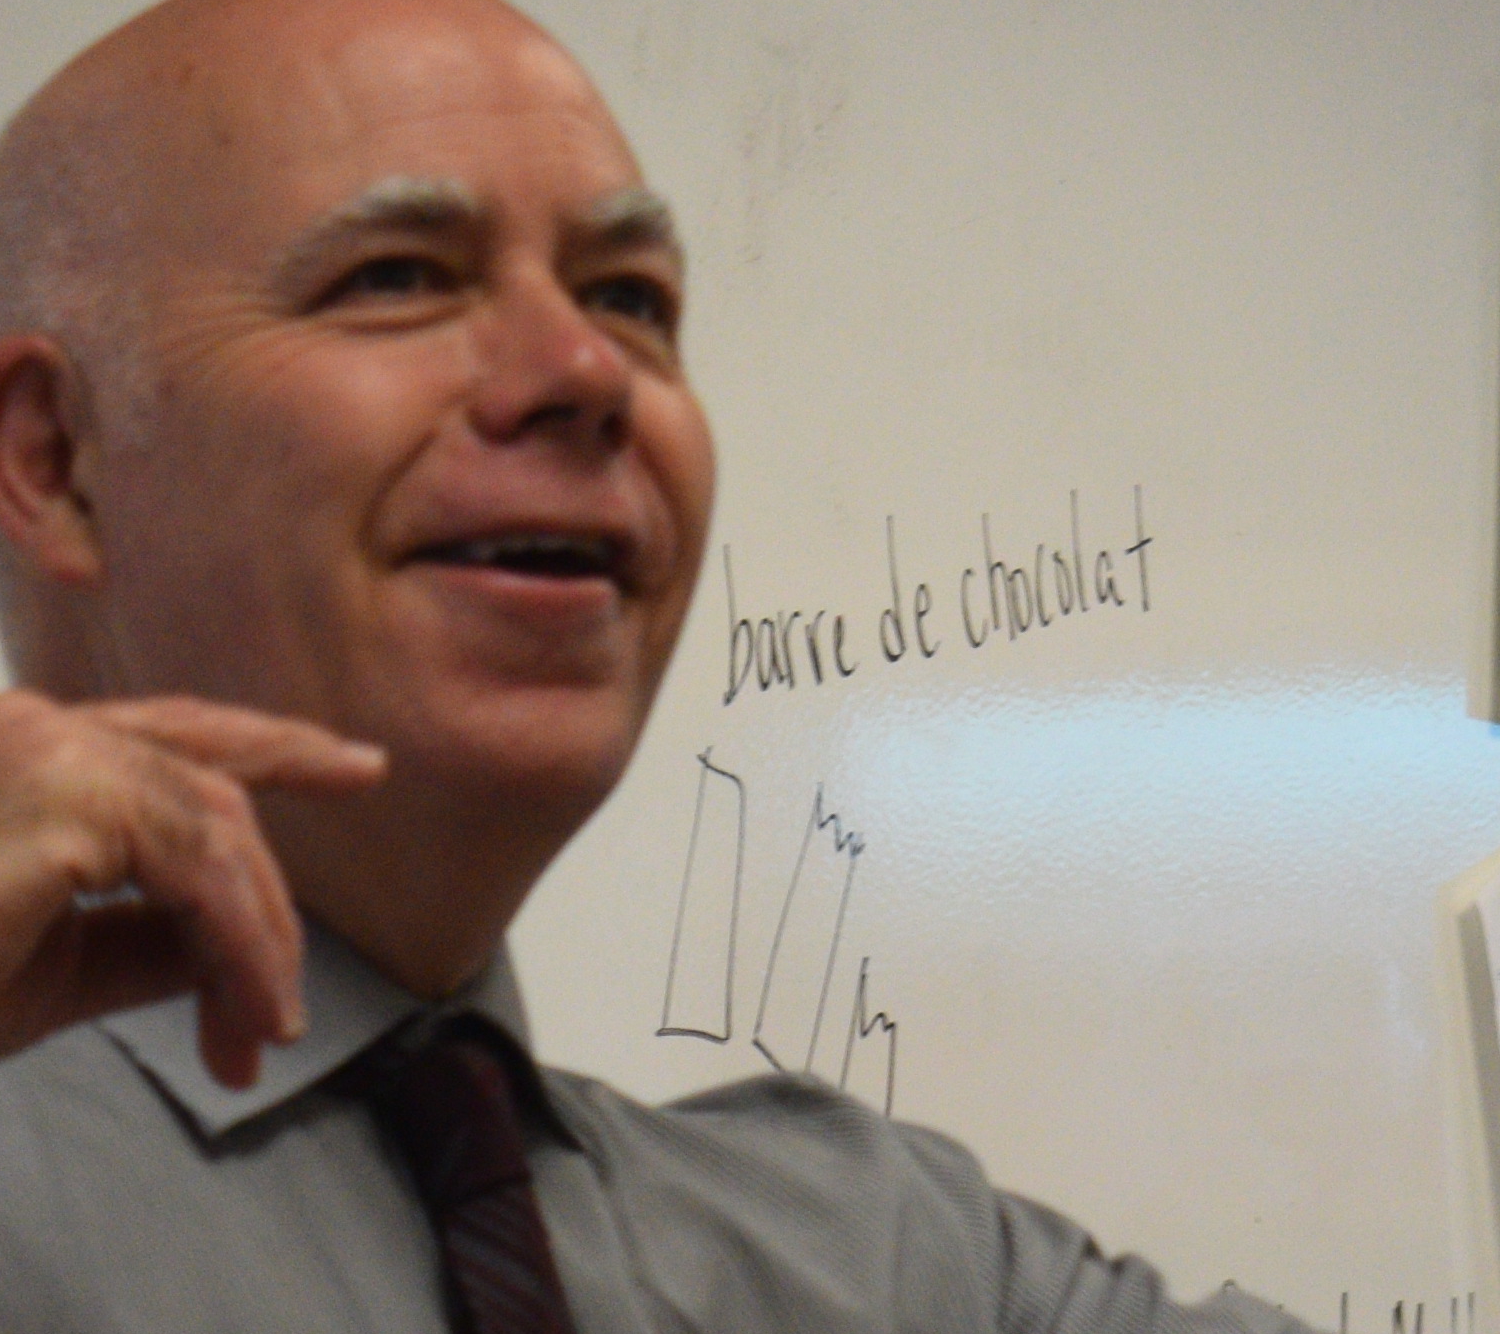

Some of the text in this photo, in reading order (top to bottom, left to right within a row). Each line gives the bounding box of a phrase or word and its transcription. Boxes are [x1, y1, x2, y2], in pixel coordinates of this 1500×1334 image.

[723, 484, 1154, 706] barre de chocolat
